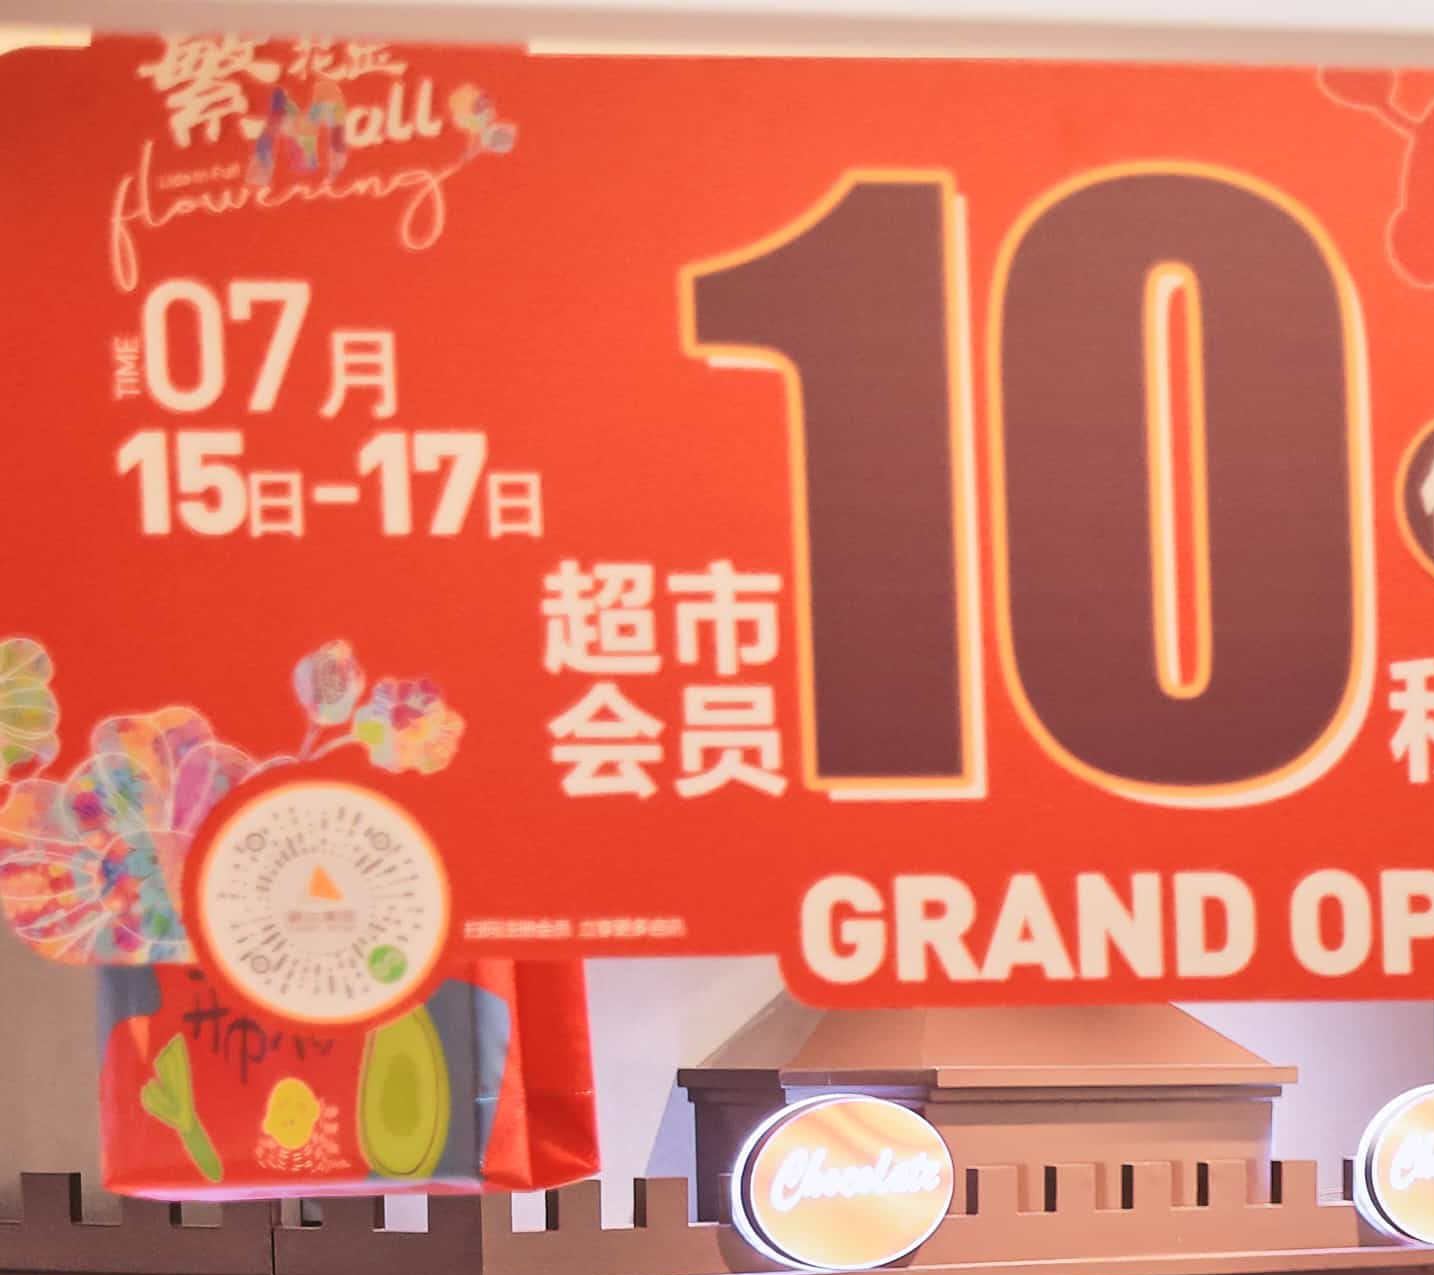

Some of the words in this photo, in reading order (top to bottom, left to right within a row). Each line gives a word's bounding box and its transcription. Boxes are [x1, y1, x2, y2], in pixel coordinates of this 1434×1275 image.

[113, 336, 141, 401] TIME
[142, 280, 398, 417] 07月
[117, 430, 545, 538] 15日-17日
[680, 160, 1376, 809] 10
[541, 559, 783, 677] 超市
[547, 683, 787, 799] 会员
[800, 868, 1256, 984] GRAND
